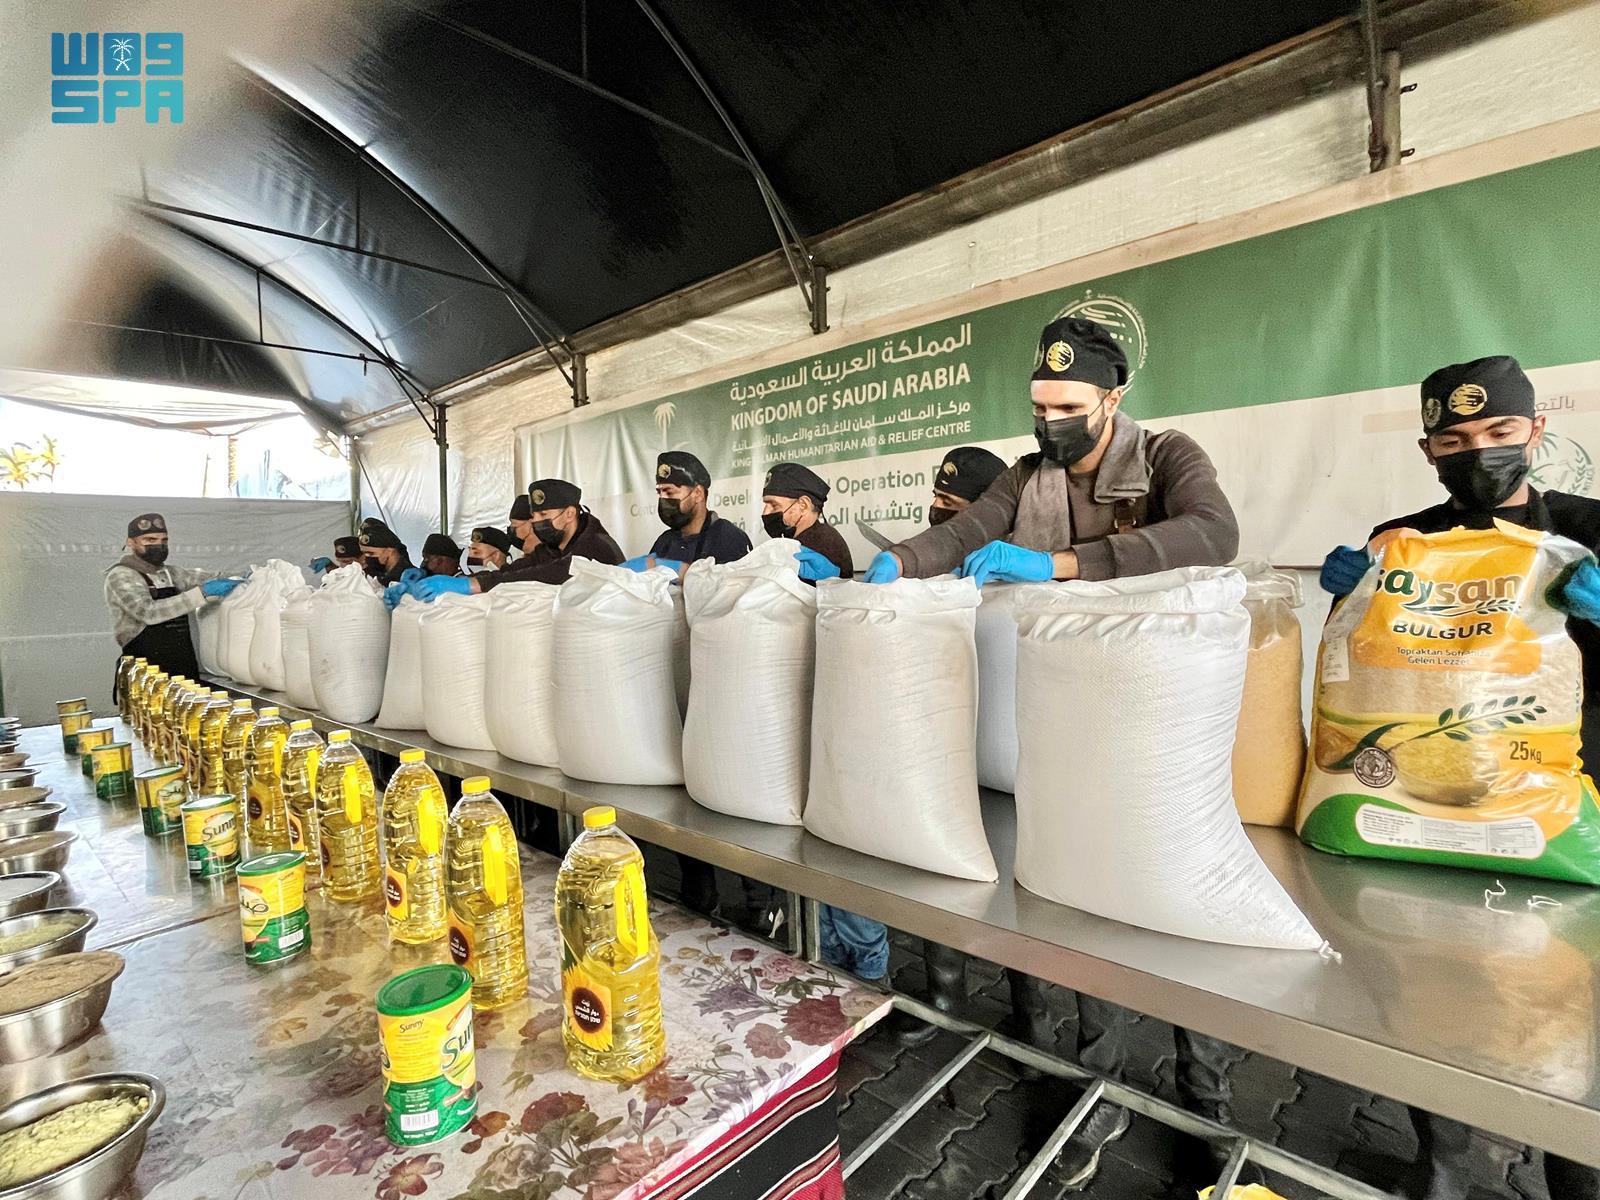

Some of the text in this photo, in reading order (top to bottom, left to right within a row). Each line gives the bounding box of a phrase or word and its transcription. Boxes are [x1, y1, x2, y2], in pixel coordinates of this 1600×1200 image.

[730, 323, 971, 405] المملكة العربية السعودية
[731, 363, 970, 431] KINGDOM OF SAUDI ARABIA
[897, 407, 935, 423] الملك
[936, 400, 971, 419] مركز
[852, 415, 896, 432] سلمان
[732, 457, 752, 468] KING
[788, 439, 859, 460] HUMANITARIAN
[861, 435, 876, 447] AID
[878, 435, 886, 445] &
[888, 427, 924, 443] RELIEF
[925, 420, 972, 436] CENTRE
[836, 470, 926, 497] Operation
[1392, 620, 1493, 640] BULGUR
[1396, 646, 1443, 657] Topraktan
[1408, 655, 1435, 665] Gelen
